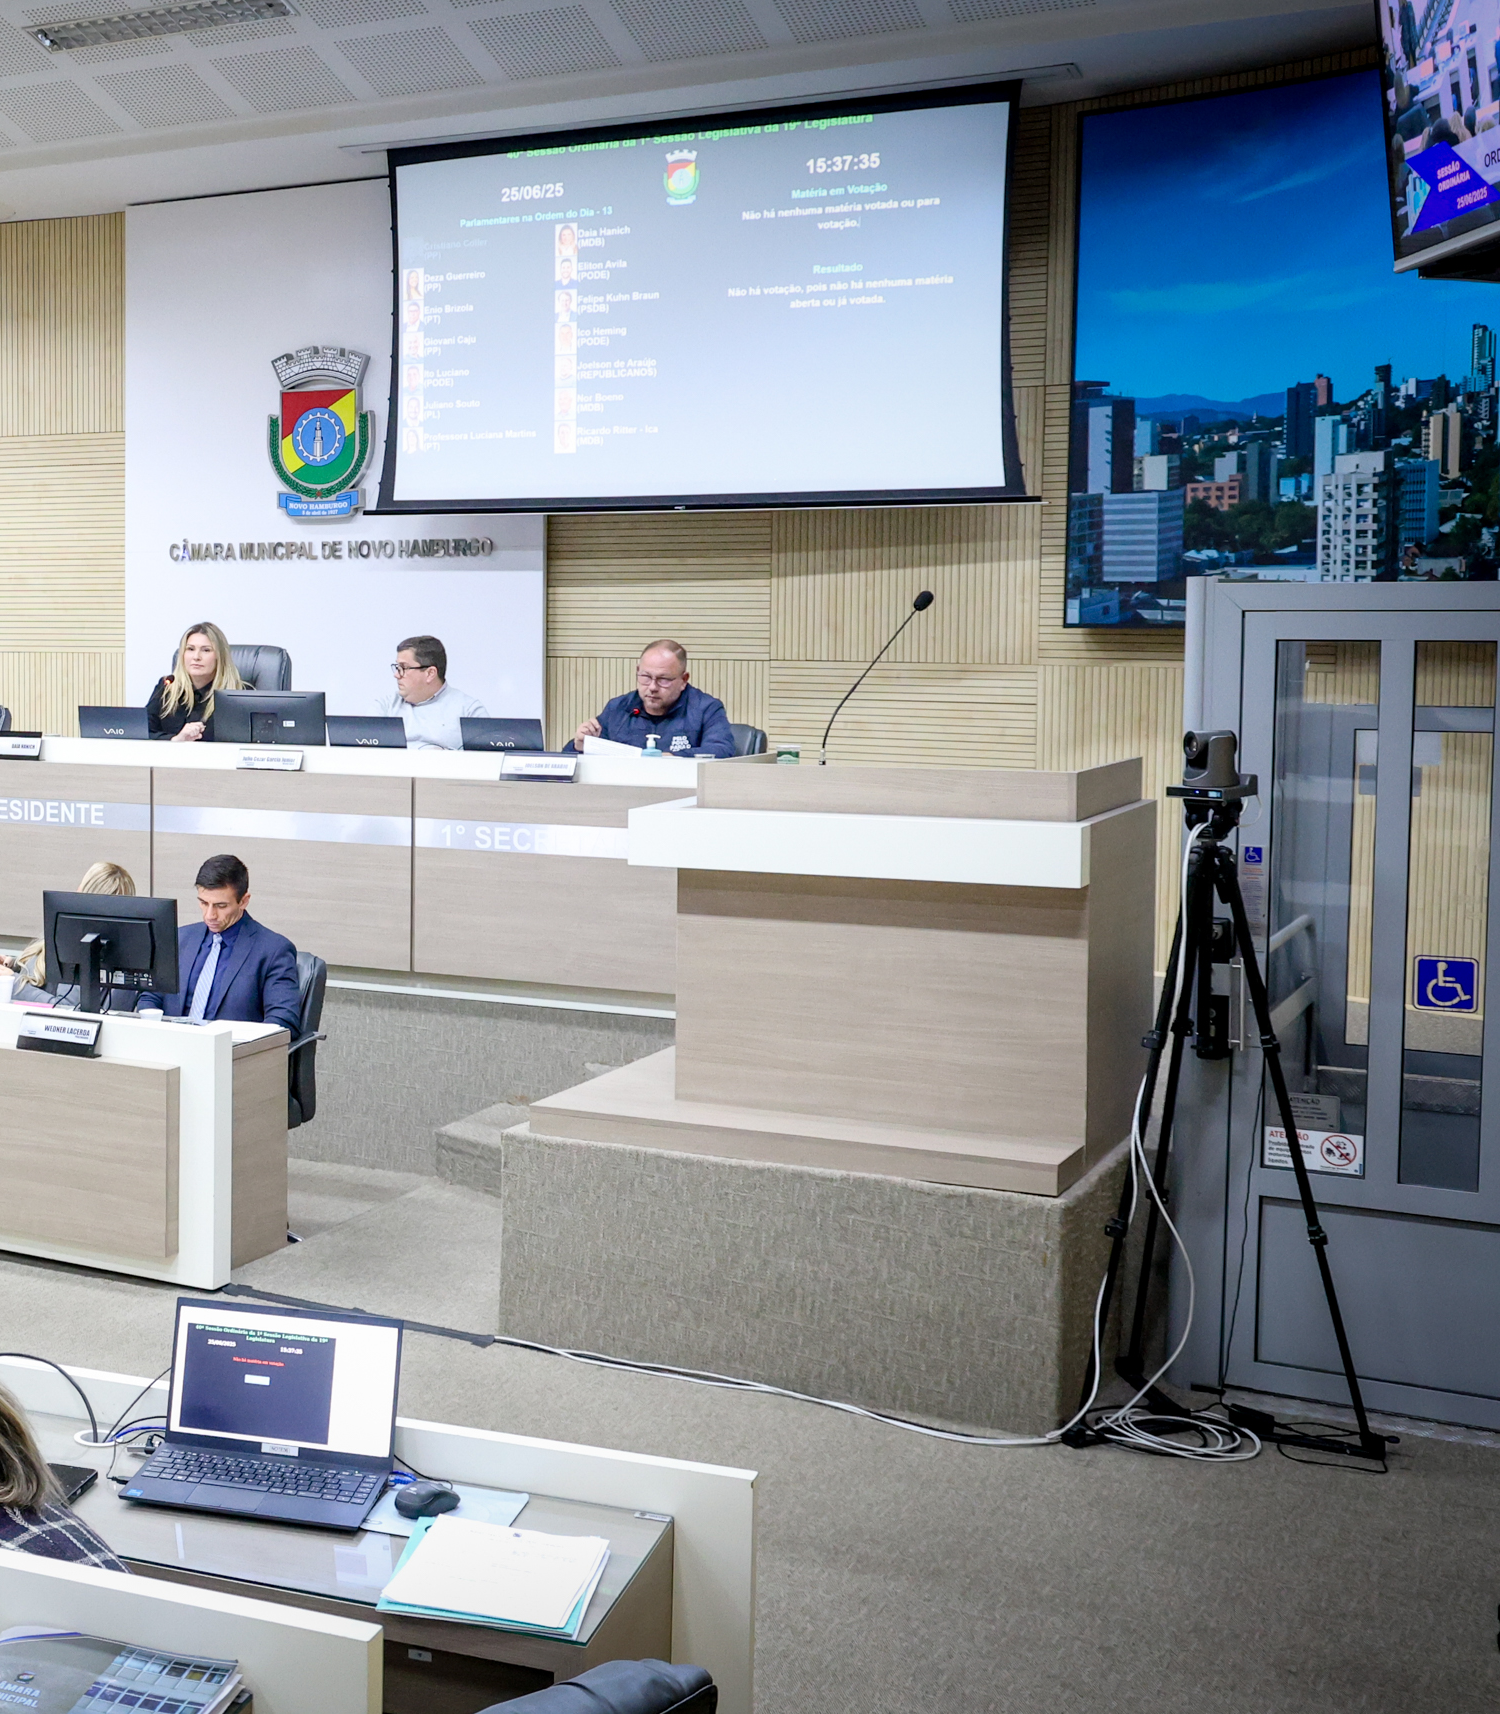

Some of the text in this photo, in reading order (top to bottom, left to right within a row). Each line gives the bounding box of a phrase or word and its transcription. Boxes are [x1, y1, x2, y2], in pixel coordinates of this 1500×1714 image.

[806, 153, 881, 174] 15:37:35
[1436, 160, 1461, 180] SESSÃO
[501, 182, 564, 203] 25/06/25
[791, 182, 888, 200] Matéria em Votação
[1456, 186, 1488, 210] 25/06/2025
[742, 197, 941, 221] Não há nenhuma matéria votada ou para
[460, 205, 613, 228] Parlamentares na Ordem do Dia 13
[817, 217, 860, 231] votação.
[578, 225, 631, 238] Daia Hanich
[578, 237, 605, 249] (MDB)
[813, 262, 864, 275] Resultado
[424, 270, 486, 283] Deza Guerreiro
[578, 270, 610, 282] (PODE)
[424, 283, 442, 293] (PP)
[728, 274, 954, 298] Não há votação, pois não há nenhuma matéria
[578, 291, 660, 305] Felipe Kuhn Braun
[790, 294, 886, 309] aberta ou já votada.
[424, 303, 474, 315] Enio Brizola
[578, 304, 609, 315] (PSDB)
[424, 315, 441, 325] (PT)
[424, 335, 477, 346] Giovani Caju
[577, 336, 610, 348] (PODE)
[424, 347, 442, 356] (PP)
[577, 357, 657, 370] Joelson de Araújo
[436, 368, 470, 378] Luciano
[577, 368, 658, 380] (REPUBLICANOS)
[424, 378, 454, 389] (PODE)
[424, 399, 481, 410] Juliano Souto
[577, 403, 604, 414] (MDB)
[424, 429, 537, 442] Professora Luciana Martins
[577, 426, 611, 436] Ricardo
[309, 502, 348, 510] HAMBURGO
[169, 537, 495, 562] CÂMARA MUNICIPAL DE NOVO HAMBURGO
[103, 727, 125, 736] VAIO
[355, 738, 380, 746] VAIO
[44, 1025, 67, 1034] WEDNER
[67, 1027, 90, 1037] LACERDA
[1269, 1130, 1310, 1141] ATEÃO
